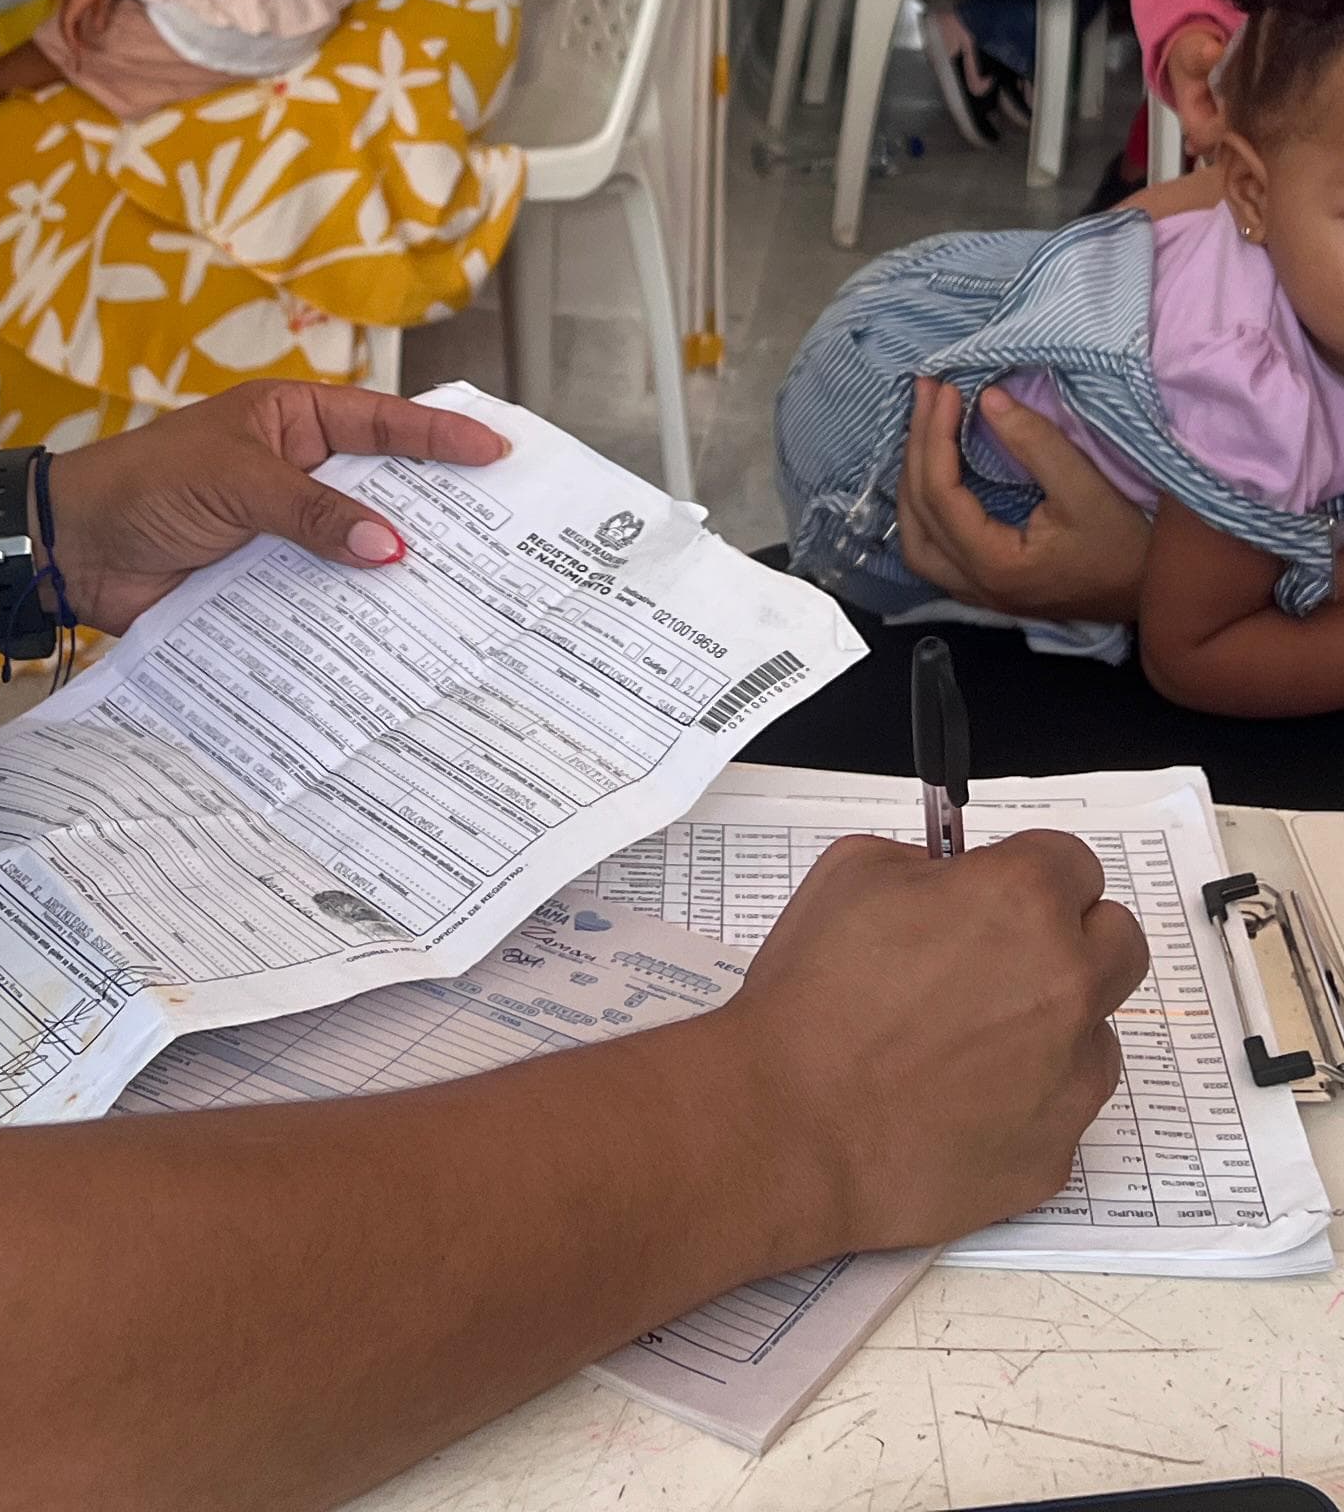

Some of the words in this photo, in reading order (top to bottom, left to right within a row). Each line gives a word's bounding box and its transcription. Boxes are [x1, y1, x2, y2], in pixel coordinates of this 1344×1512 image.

[515, 539, 535, 556] DE
[525, 530, 589, 576] REGISTRO
[587, 569, 618, 588] CIVIL
[652, 608, 728, 660] 0210019638
[640, 654, 669, 677] Código
[1106, 1207, 1153, 1219] GRUPO
[1175, 1207, 1211, 1219] SEDE
[1235, 1208, 1264, 1219] AÑO
